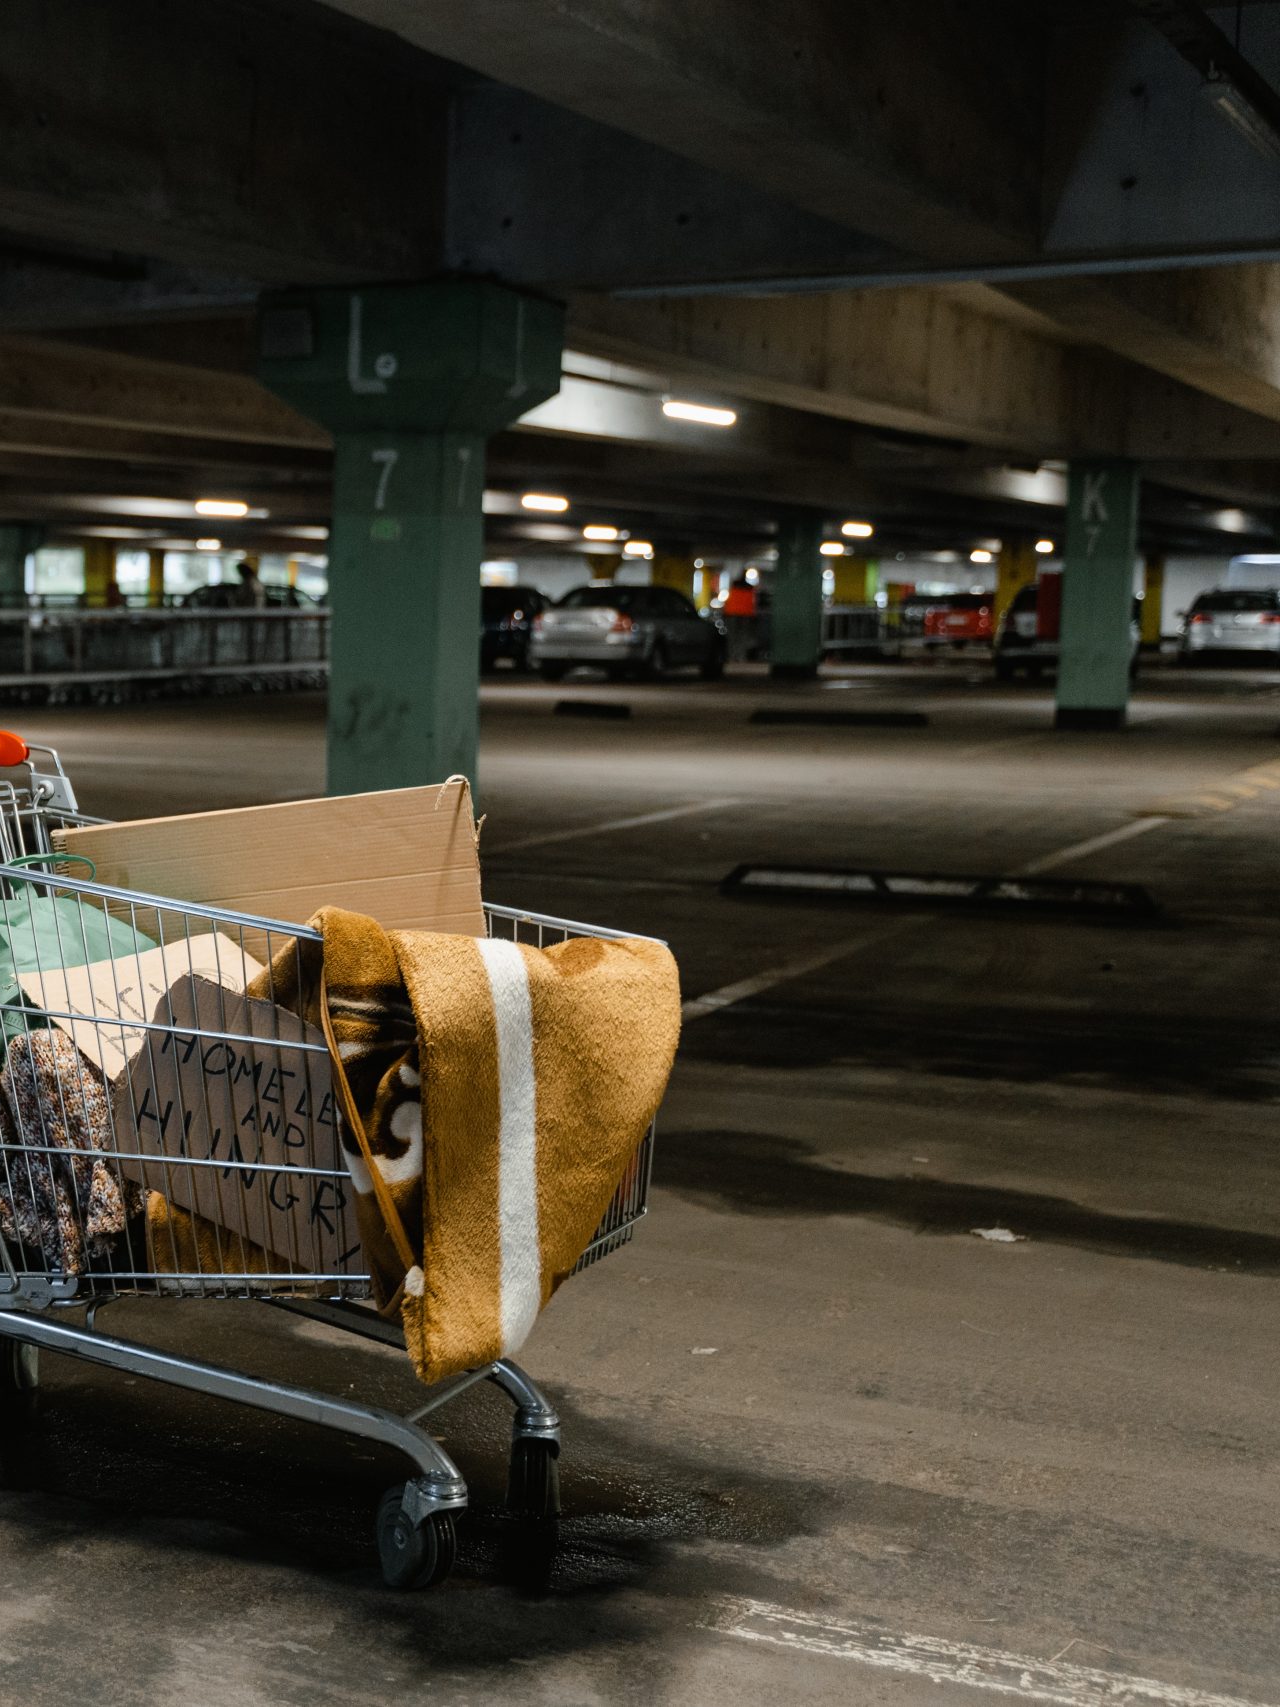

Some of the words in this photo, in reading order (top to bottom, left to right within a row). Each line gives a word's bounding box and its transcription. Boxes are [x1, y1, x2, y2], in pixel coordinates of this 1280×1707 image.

[348, 295, 389, 394] L
[370, 448, 399, 511] 7
[1081, 469, 1109, 522] K
[241, 1102, 306, 1148] AND
